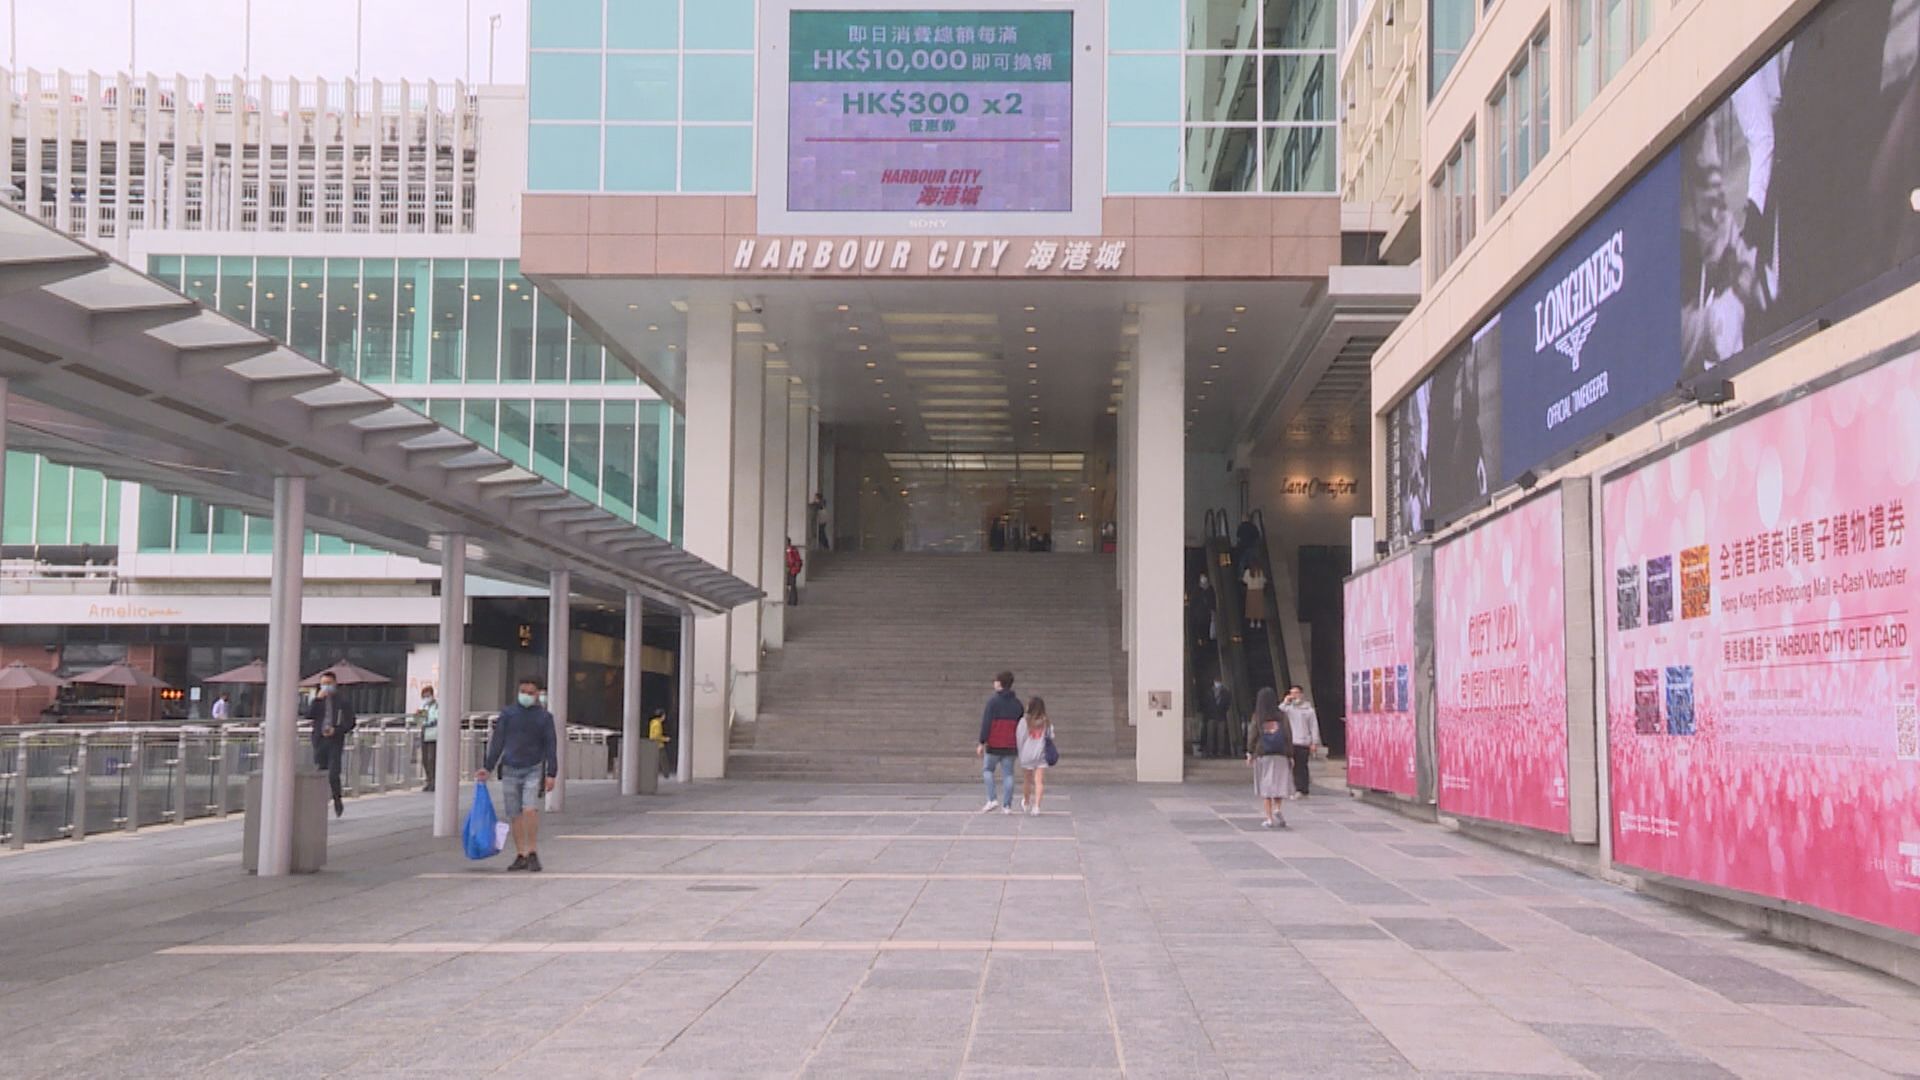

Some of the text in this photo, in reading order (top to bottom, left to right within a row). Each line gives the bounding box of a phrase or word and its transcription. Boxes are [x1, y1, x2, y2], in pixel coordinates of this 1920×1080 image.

[848, 26, 1017, 43] 即日消費總額每滿
[813, 47, 1053, 73] HK$10,000 即可換領
[842, 89, 1023, 117] HK$300 x2
[908, 119, 956, 133] 優惠券
[880, 169, 982, 184] HARBOUR CITY
[915, 185, 983, 206] 海港城
[909, 219, 948, 229] SONY
[733, 238, 1126, 271] HARBOUR CITY 海港城
[1534, 229, 1625, 353] LONGINES
[1546, 370, 1609, 431] OFFICIAL TIMEKEEPER
[1280, 477, 1308, 495] Lane
[1738, 591, 1758, 611] Kong
[1757, 587, 1775, 606] First
[1775, 584, 1812, 605] Shopping
[1813, 577, 1830, 597] Mall
[1832, 571, 1865, 595] e-Cash
[1865, 566, 1907, 589] Voucher
[1775, 631, 1820, 658] HARBOUR
[1822, 628, 1847, 652] CITY
[1847, 626, 1871, 651] GIFT
[1873, 622, 1908, 649] CARD
